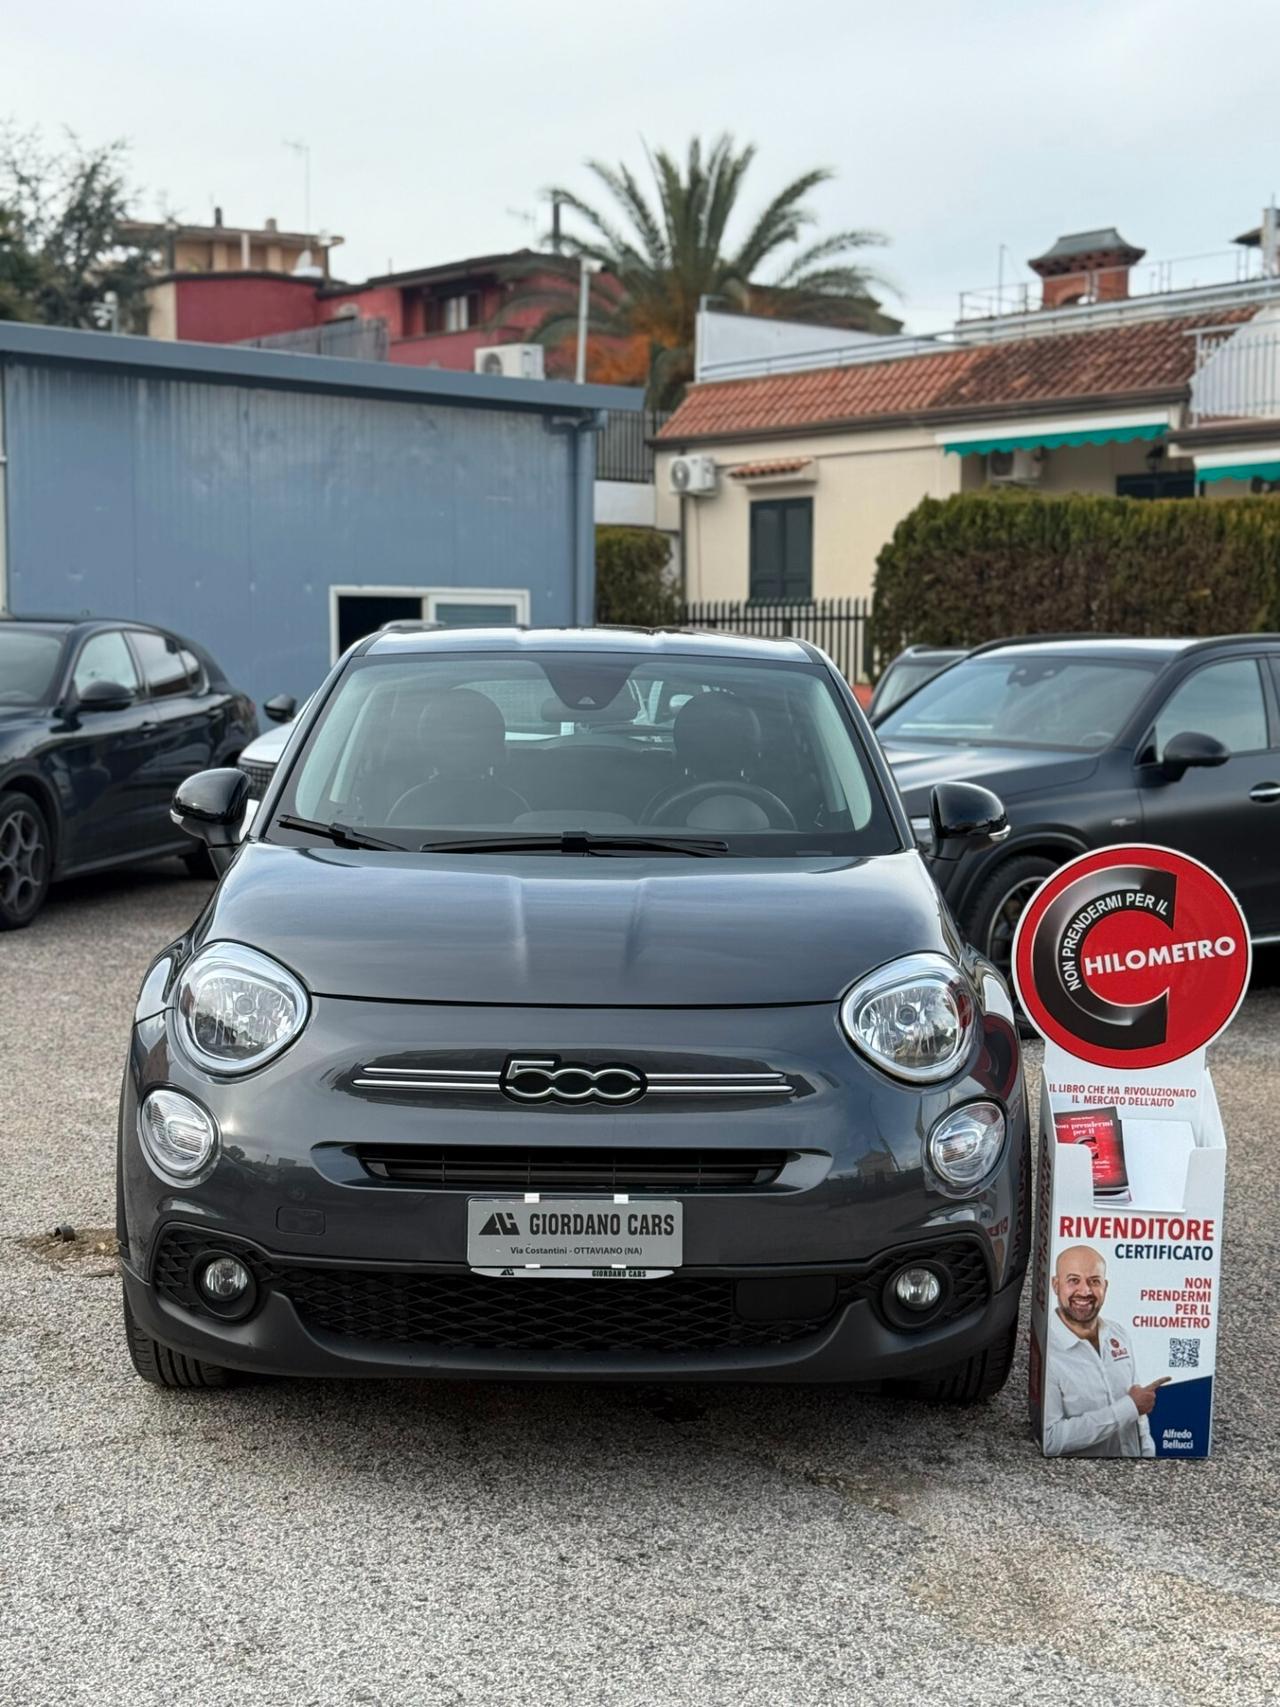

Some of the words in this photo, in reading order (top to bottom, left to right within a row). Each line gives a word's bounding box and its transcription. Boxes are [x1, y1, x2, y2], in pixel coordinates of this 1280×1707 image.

[1126, 892, 1155, 909] PER
[1156, 899, 1169, 916] IL
[1062, 894, 1122, 958] PRENDERMI
[1062, 959, 1082, 992] NON
[504, 1059, 642, 1101] 500
[1049, 1083, 1057, 1093] IL
[1059, 1084, 1085, 1094] LIBRO
[1087, 1085, 1105, 1095] CHE
[1107, 1086, 1120, 1095] HA
[1124, 1086, 1197, 1098] RIVOLUZIONATO
[1071, 1095, 1080, 1104] IL
[1083, 1096, 1126, 1106] MERCATO
[1128, 1097, 1175, 1107] DELL'AUTO
[529, 1213, 621, 1236] GIORDANO
[627, 1213, 675, 1236] CARS
[1059, 1216, 1215, 1241] RIVENDITORE
[510, 1246, 524, 1255] Via
[525, 1246, 568, 1255] Costantini
[574, 1247, 623, 1255] OTTAVIANO
[624, 1246, 643, 1256] (NA)
[1114, 1243, 1214, 1261] CERTIFICATO
[591, 1269, 627, 1278] GIORDANO
[628, 1270, 647, 1278] CARS
[1184, 1277, 1212, 1289] NON
[1140, 1289, 1212, 1302] PRENDERMI
[1175, 1303, 1198, 1315] PER
[1200, 1304, 1212, 1316] IL
[1132, 1315, 1211, 1328] CHILOMETRO
[1162, 1429, 1193, 1439] Alfredo
[1162, 1439, 1194, 1449] Bellucci
